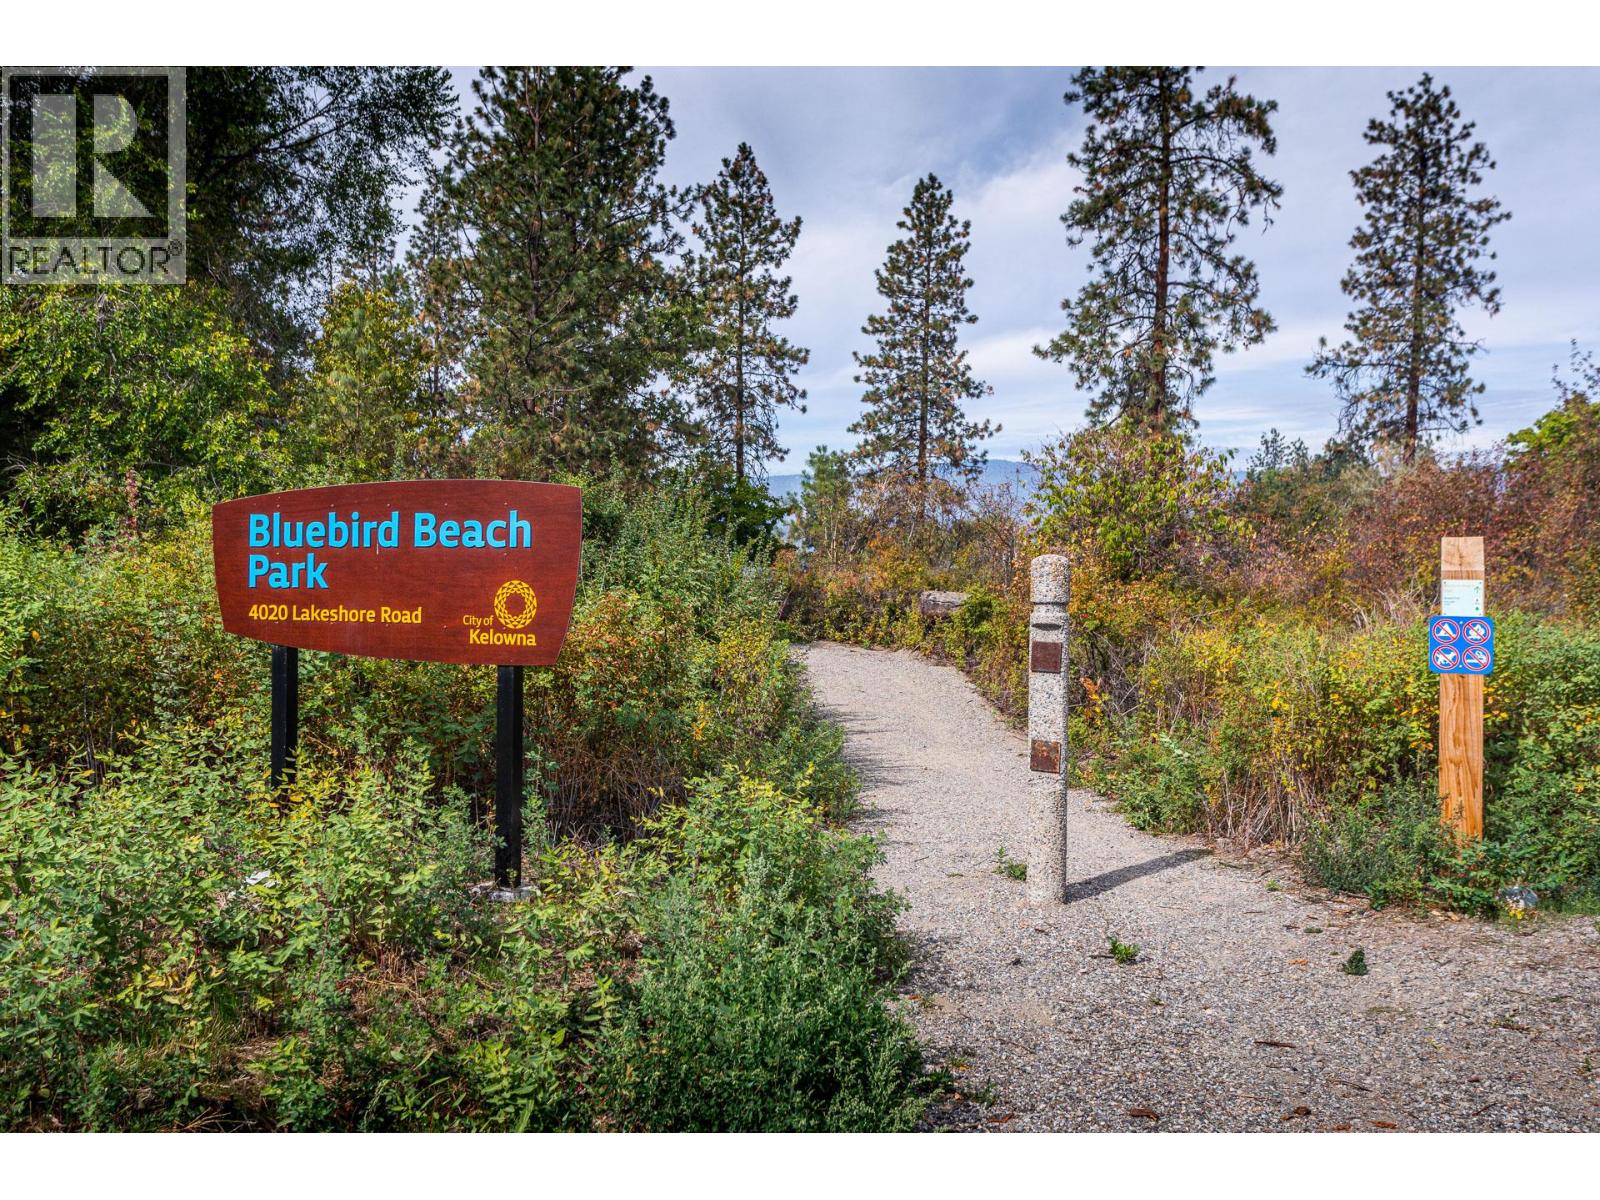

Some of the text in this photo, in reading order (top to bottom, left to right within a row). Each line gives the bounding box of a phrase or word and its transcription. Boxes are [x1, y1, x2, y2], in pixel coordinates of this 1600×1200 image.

[249, 510, 532, 549] Bluebird Beach
[248, 553, 329, 590] Park
[248, 605, 422, 624] 4020 Lakeshore Road
[462, 615, 494, 627] City of
[469, 629, 536, 646] Kelowna
